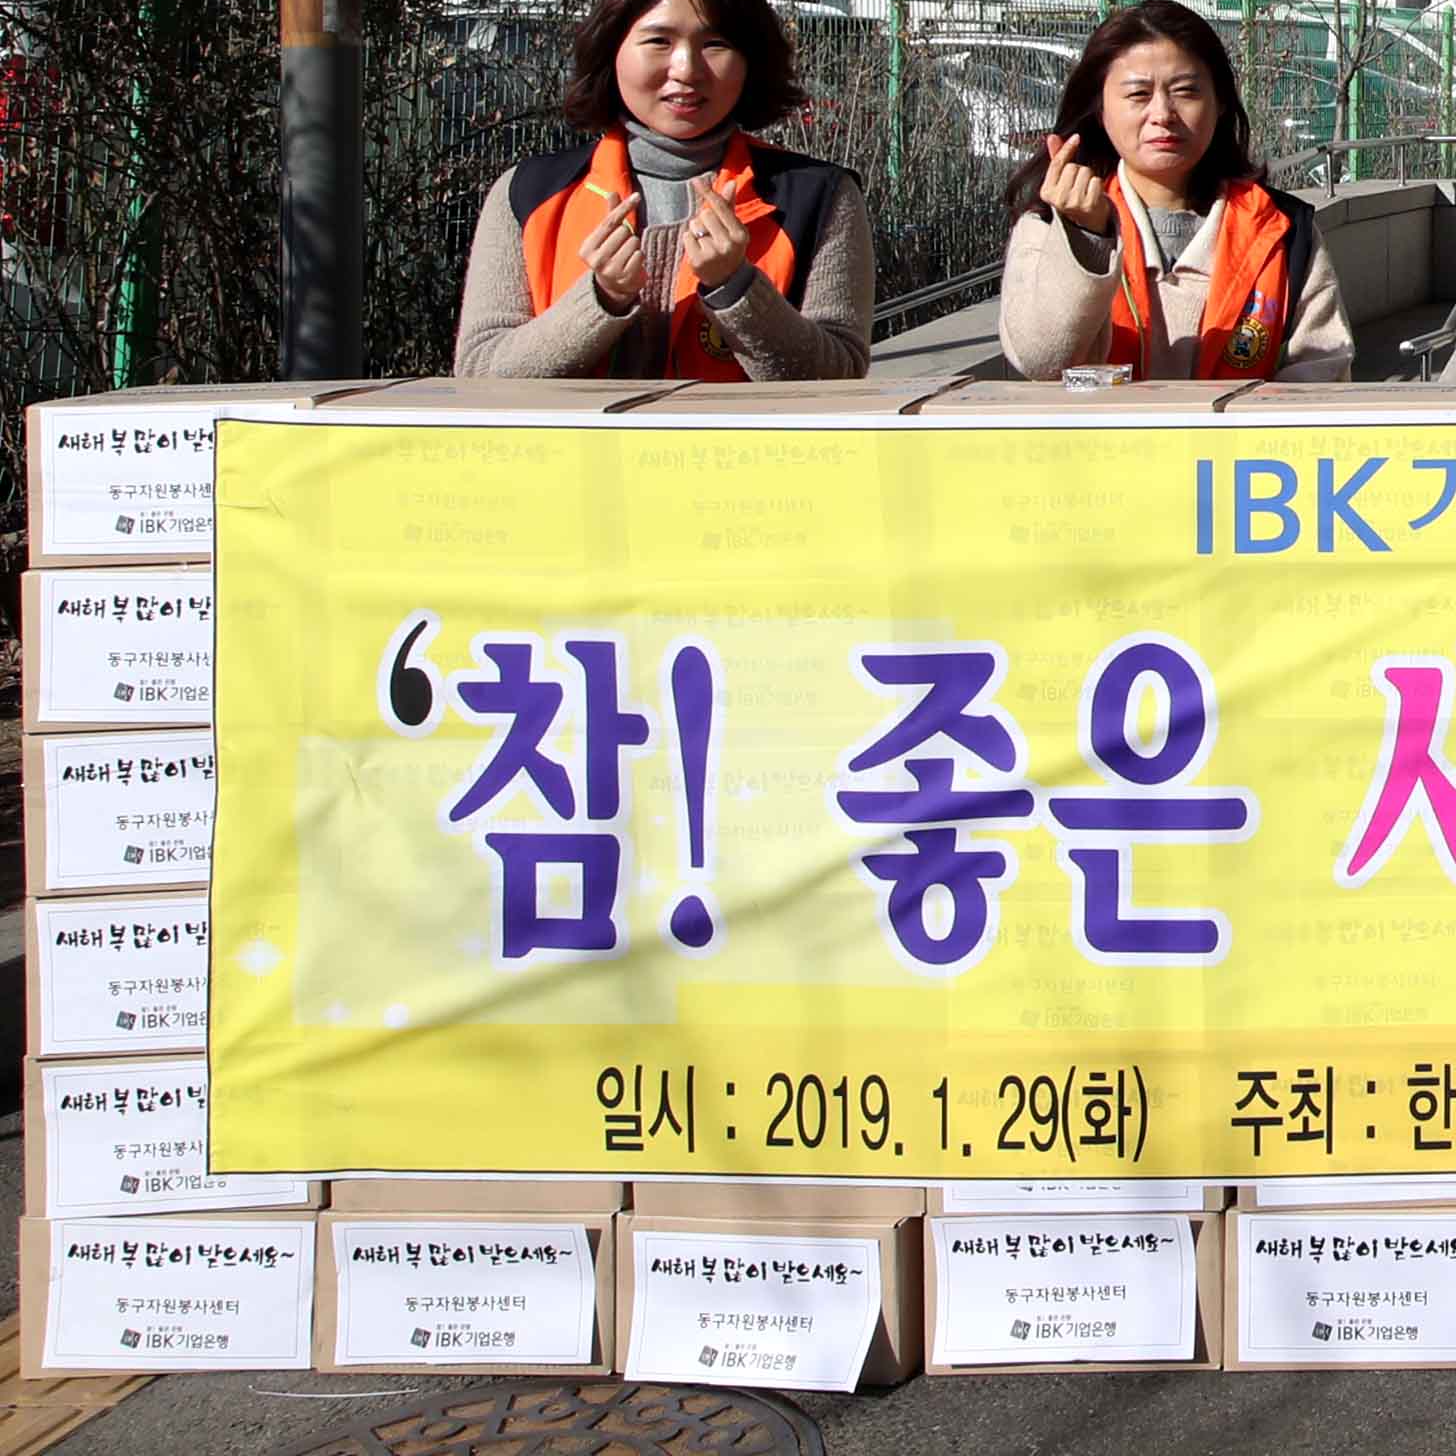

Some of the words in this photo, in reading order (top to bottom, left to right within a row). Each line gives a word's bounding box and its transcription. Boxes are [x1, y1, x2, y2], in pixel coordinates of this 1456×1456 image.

[836, 643, 1250, 965] 좋은
[594, 1065, 698, 1153] 일시
[997, 1064, 1150, 1158] 29(화)
[1230, 1065, 1337, 1155] 주최
[67, 1242, 116, 1264] 새해
[121, 1240, 139, 1268] 복
[145, 1242, 192, 1268] 많이
[352, 1245, 400, 1265] 새해
[405, 1242, 422, 1269] 복
[428, 1242, 475, 1267] 많이
[951, 1237, 999, 1257] 새해
[1005, 1233, 1022, 1260] 복
[1027, 1233, 1074, 1258] 많이
[1255, 1237, 1303, 1259] 새해
[1308, 1235, 1326, 1264] 복
[1332, 1235, 1378, 1262] 많이
[115, 1297, 240, 1316] 동구자원봉사센터
[404, 1295, 526, 1313] 동구자원봉사센터
[1005, 1284, 1126, 1304] 동구자원봉사센터
[1304, 1290, 1428, 1308] 동구자원봉사센터
